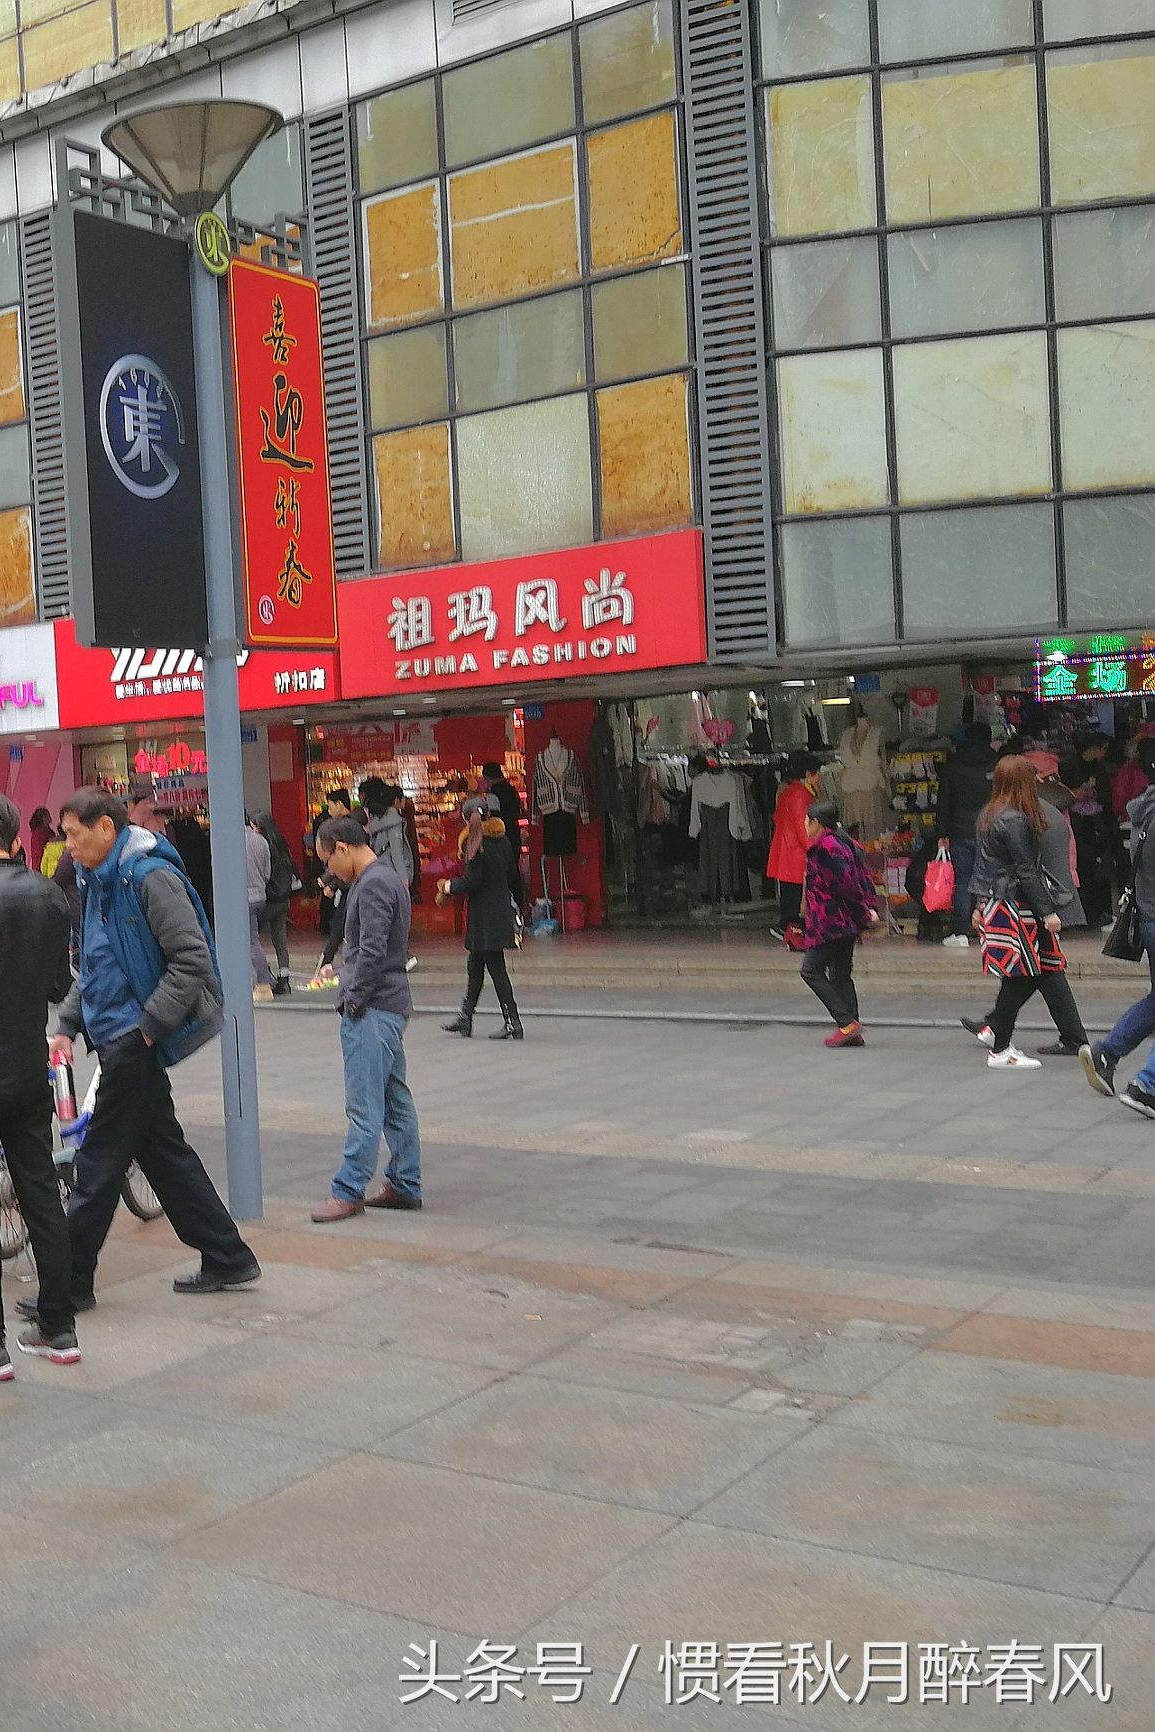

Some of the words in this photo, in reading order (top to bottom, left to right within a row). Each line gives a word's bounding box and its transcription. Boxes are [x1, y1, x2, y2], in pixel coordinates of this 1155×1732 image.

[257, 295, 315, 609] 喜迎新春
[387, 567, 635, 651] 祖玛风尚
[274, 667, 326, 694] 折扣店
[394, 652, 478, 680] ZUMA
[493, 633, 637, 669] FASHION
